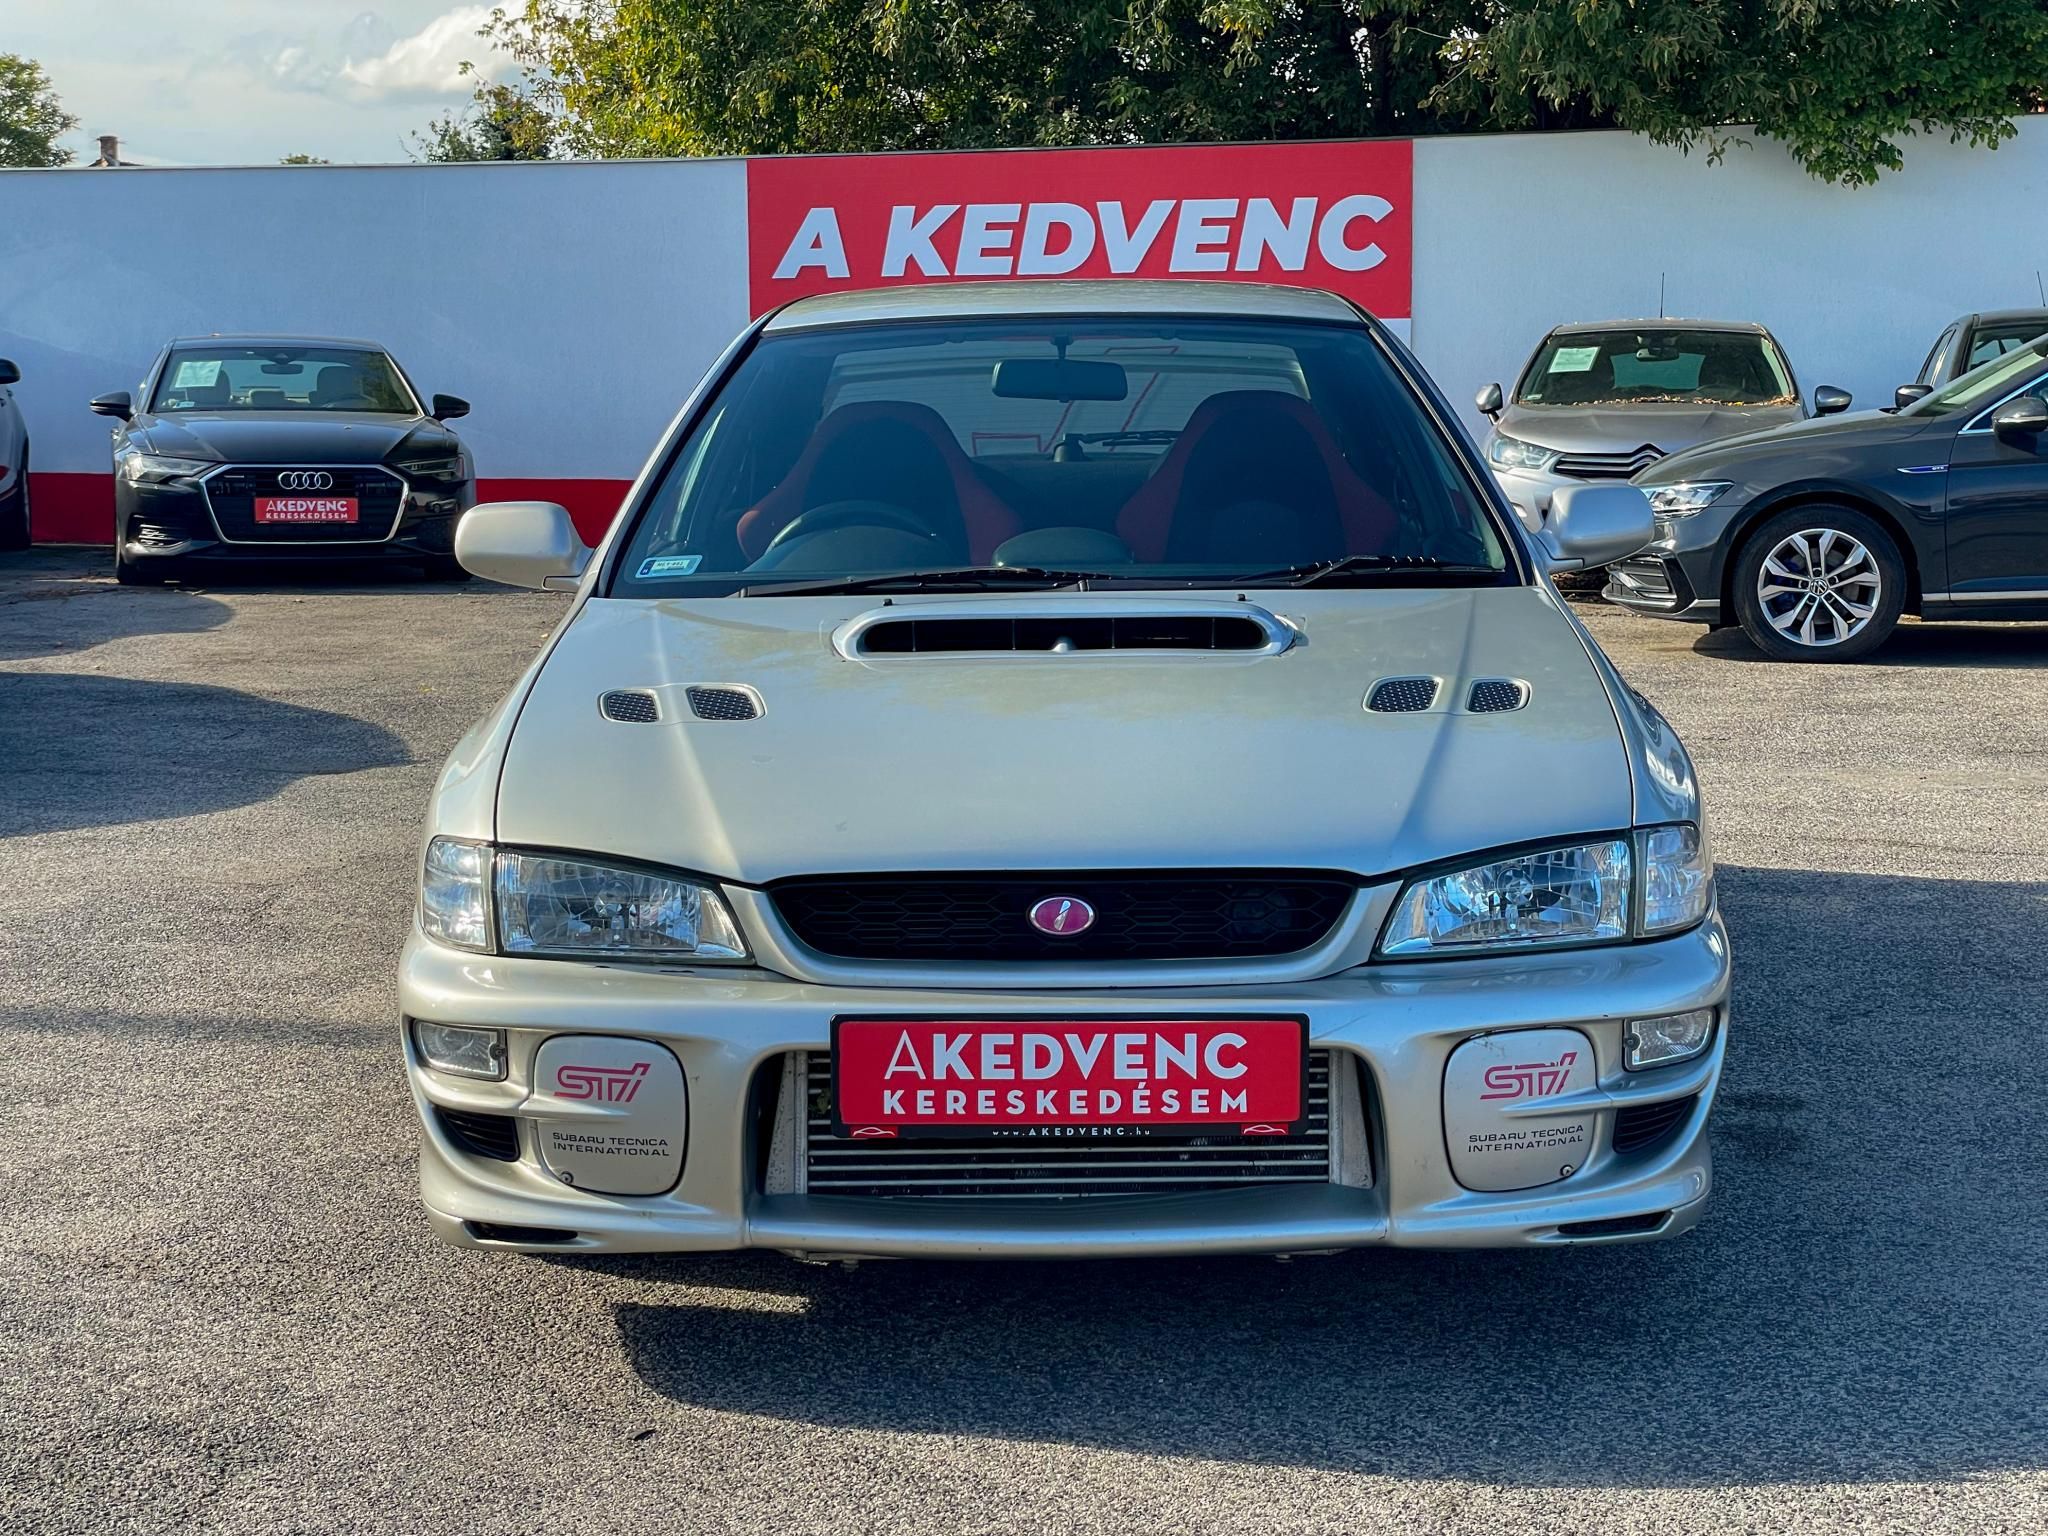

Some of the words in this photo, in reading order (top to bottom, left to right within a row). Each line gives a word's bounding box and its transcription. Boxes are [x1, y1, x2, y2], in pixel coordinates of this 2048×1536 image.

[772, 207, 851, 279] A
[881, 194, 1395, 278] KEDVENC
[883, 1082, 1247, 1115] KERESKEDÉSEM
[552, 1132, 605, 1144] SUBARU
[609, 1137, 668, 1146] TECNICA
[992, 1126, 1150, 1136] www.AKEDVENC.hu
[1469, 1131, 1526, 1143] SUBARU
[1531, 1124, 1584, 1138] TECNICA
[553, 1142, 669, 1156] INTERNATIONAL
[1468, 1135, 1583, 1153] INTERNATIONAL
